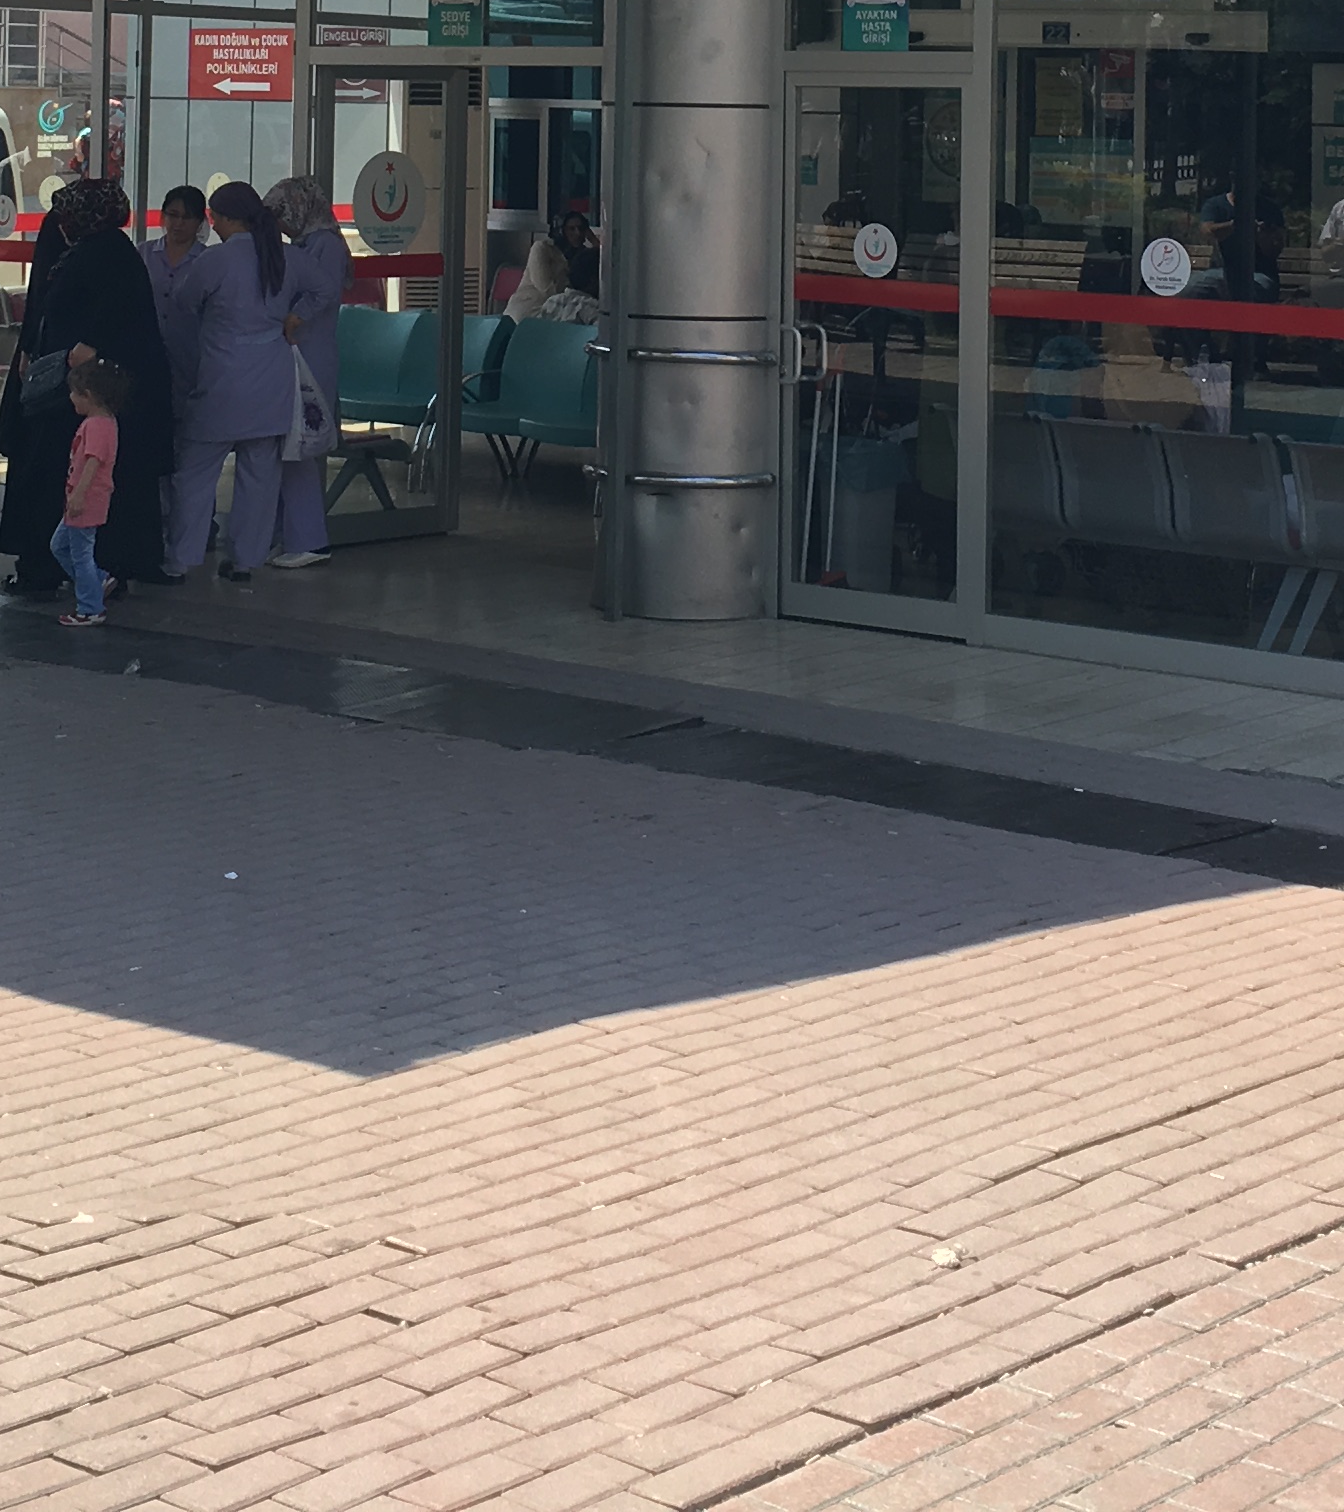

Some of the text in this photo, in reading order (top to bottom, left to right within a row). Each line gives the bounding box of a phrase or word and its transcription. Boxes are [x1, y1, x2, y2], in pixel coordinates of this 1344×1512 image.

[440, 10, 471, 22] SEDYE
[856, 10, 898, 20] AYAKTAN
[861, 22, 891, 31] HASTA
[194, 34, 218, 46] KADIN
[220, 32, 249, 46] DOĞUM
[251, 37, 260, 46] ve
[323, 30, 359, 42] ENGELLİ
